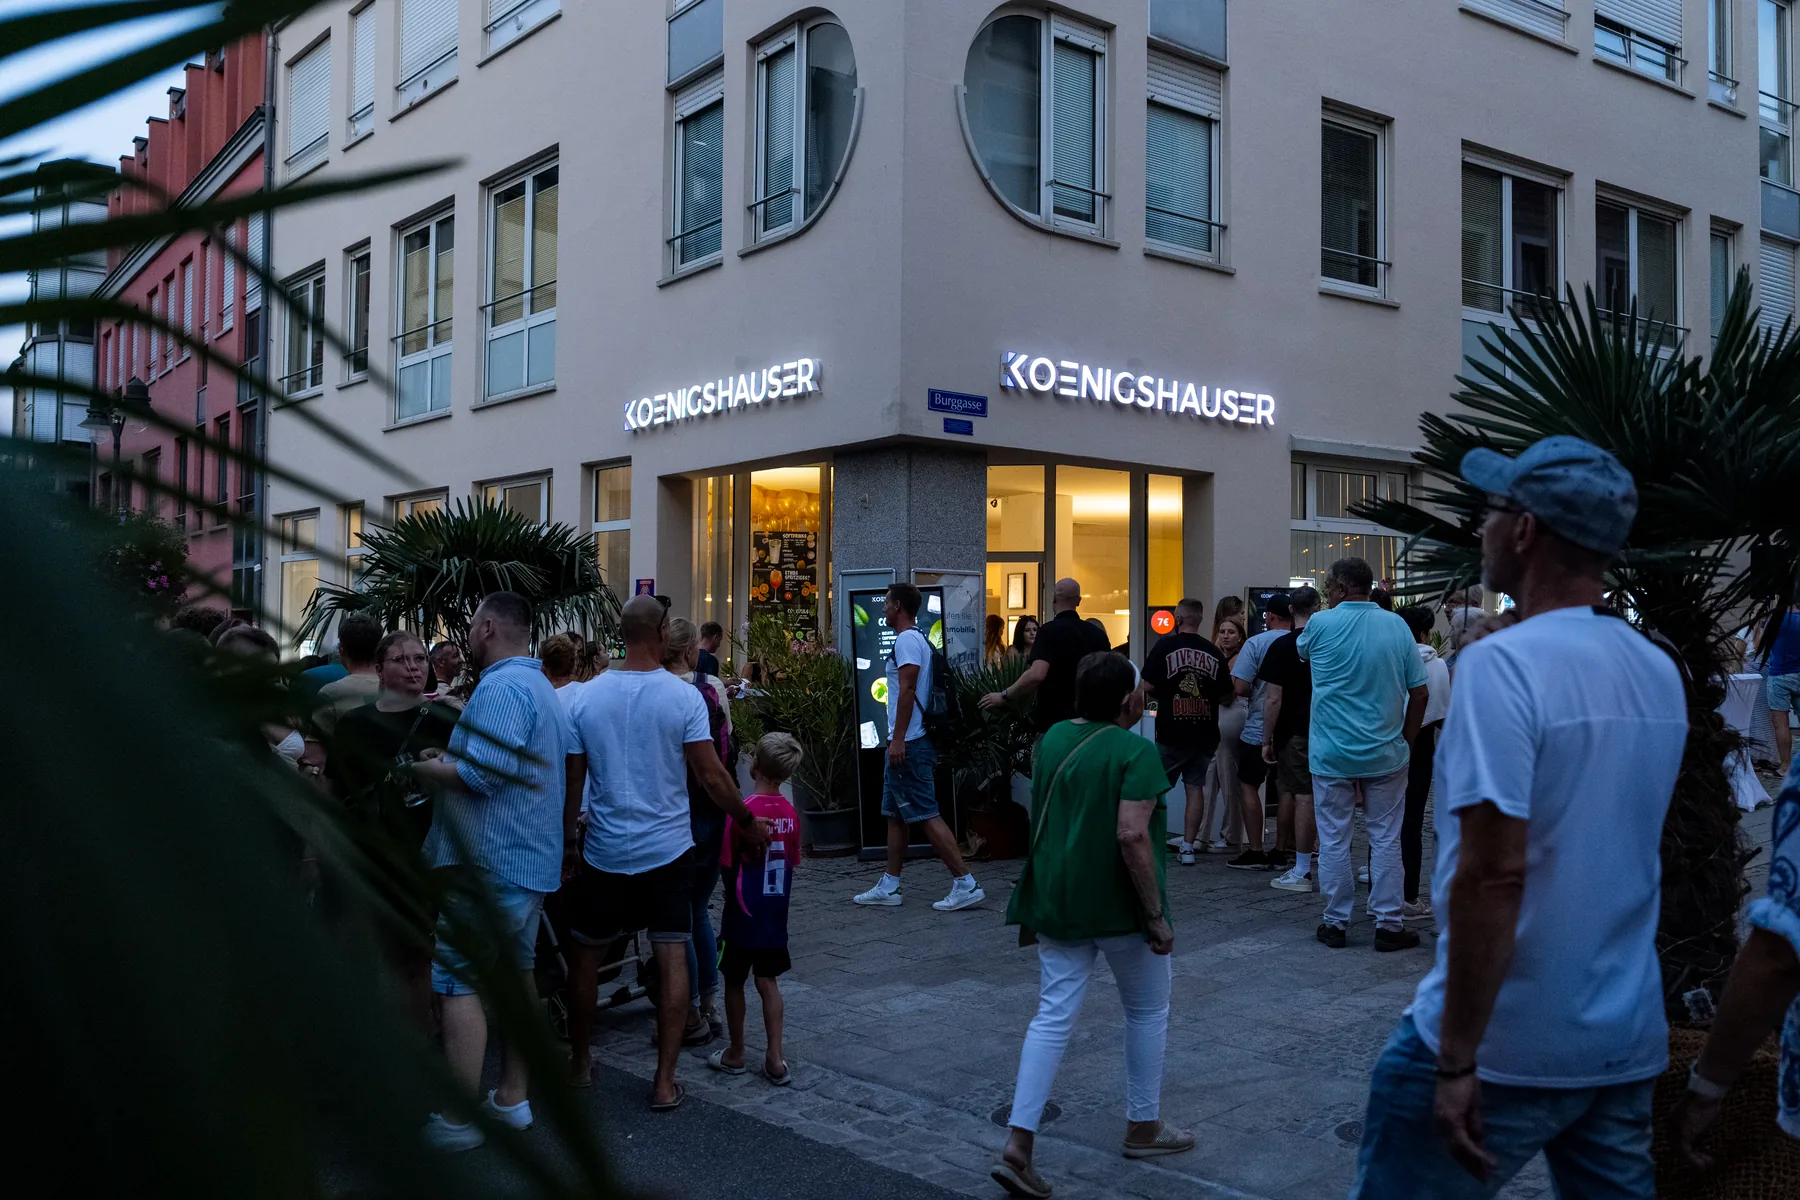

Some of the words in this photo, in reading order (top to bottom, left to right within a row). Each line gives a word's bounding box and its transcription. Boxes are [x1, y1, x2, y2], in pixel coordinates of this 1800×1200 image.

[624, 357, 815, 431] KOENIGSHAUSER
[934, 393, 982, 410] Burggasse
[1006, 351, 1275, 425] KOENIGSHAUSER
[961, 611, 973, 620] Sie
[1157, 617, 1170, 627] 7€
[1165, 648, 1192, 679] LIVE
[1193, 650, 1220, 680] FAST
[763, 841, 785, 896] 6
